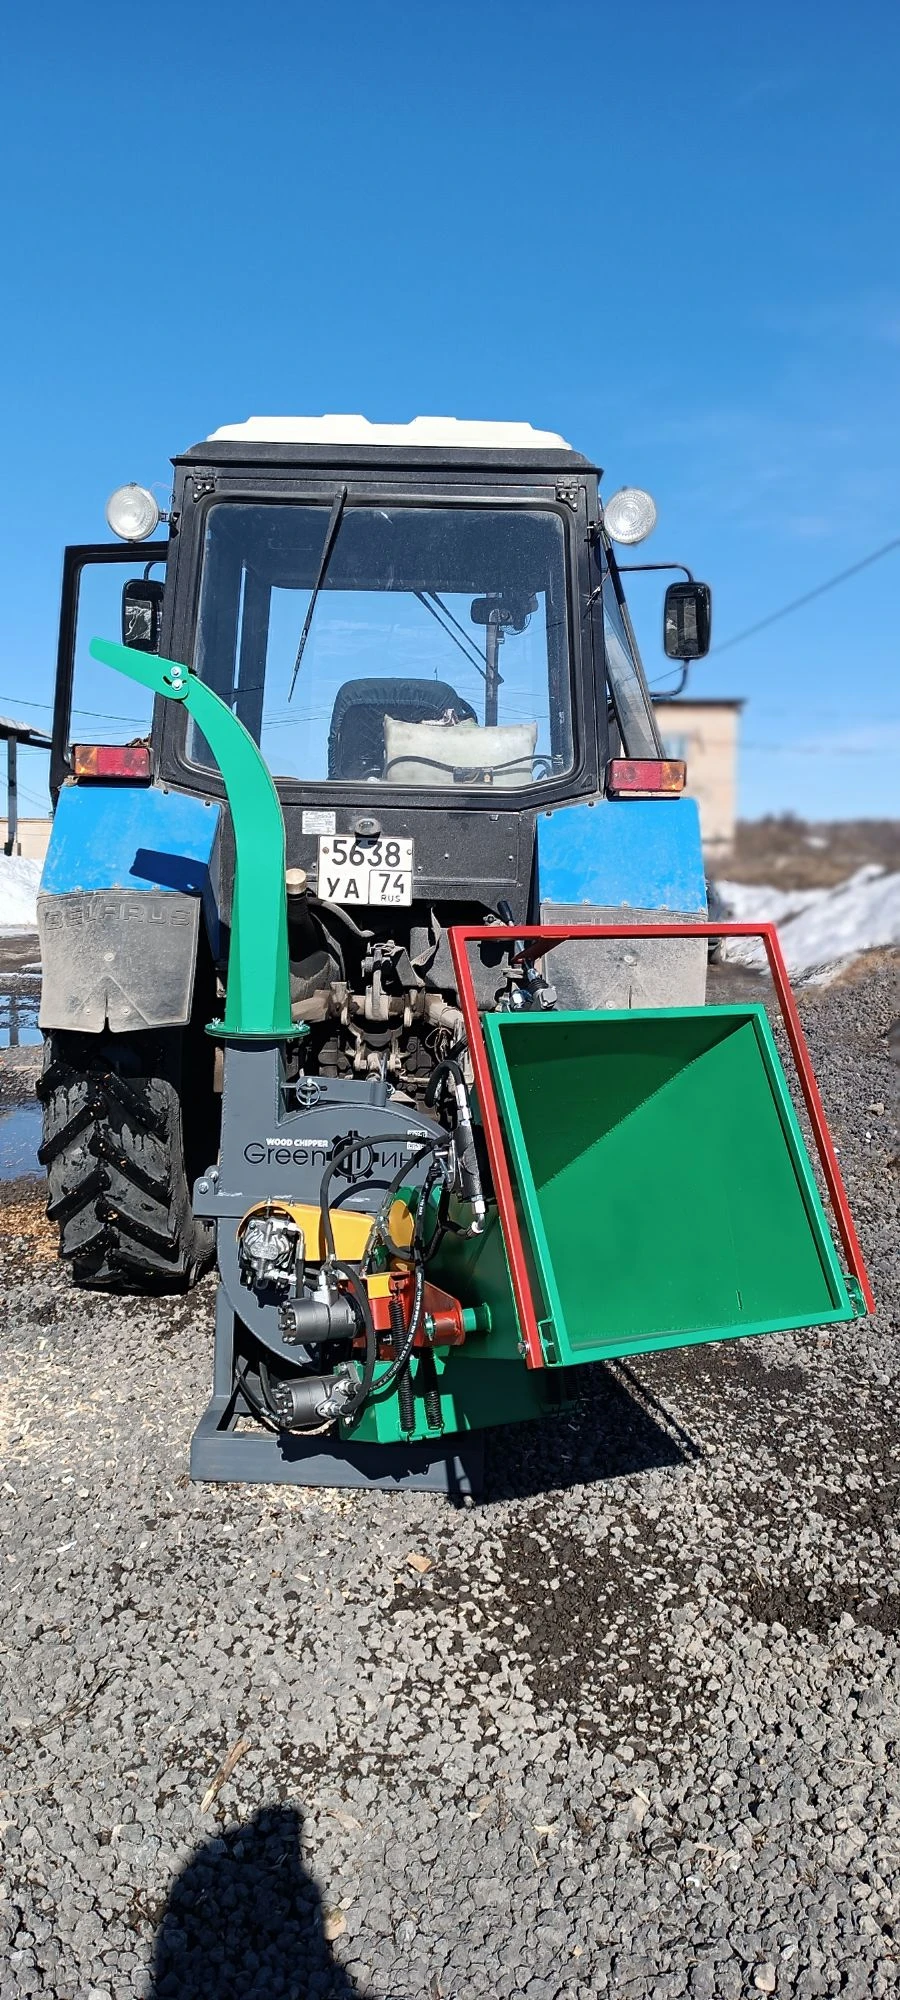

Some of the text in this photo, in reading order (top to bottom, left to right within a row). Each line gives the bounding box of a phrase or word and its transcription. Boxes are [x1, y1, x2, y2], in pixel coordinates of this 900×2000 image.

[332, 839, 401, 867] 5638
[379, 873, 405, 894] 74
[380, 895, 401, 903] RUS
[43, 902, 192, 931] BELARUS
[266, 1137, 329, 1148] WOOD CHIPPER
